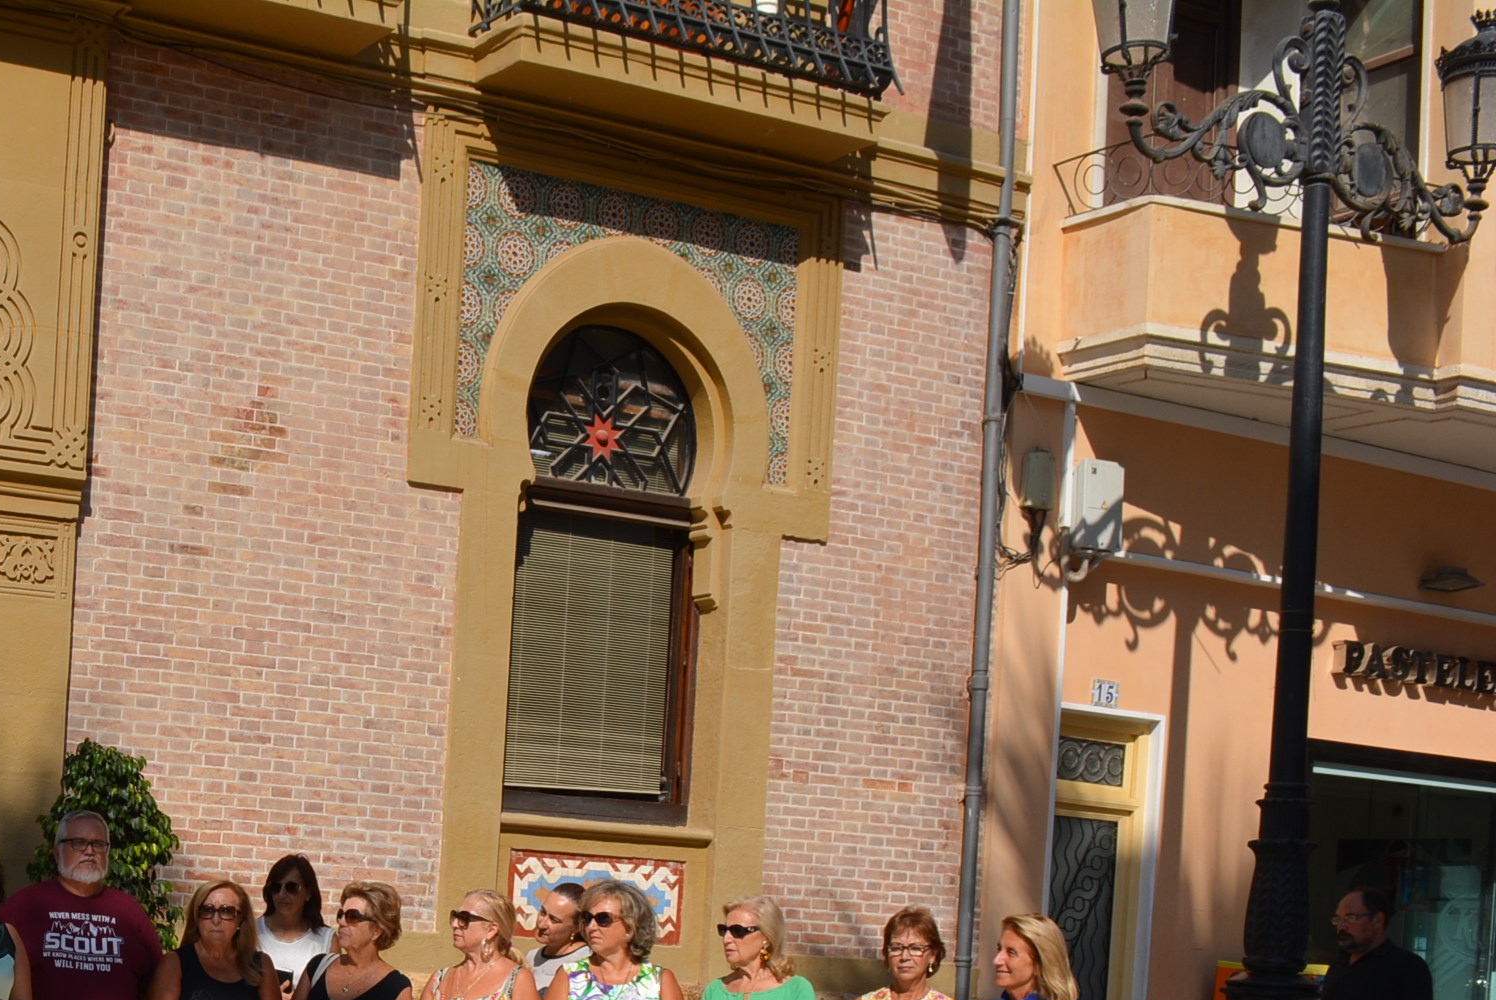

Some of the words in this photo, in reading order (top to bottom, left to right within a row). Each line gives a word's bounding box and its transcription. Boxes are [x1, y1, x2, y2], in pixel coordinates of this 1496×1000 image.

[1097, 684, 1114, 703] 15
[49, 911, 70, 920] NEVER
[71, 912, 90, 921] MESS
[91, 914, 110, 923] WITH
[44, 932, 123, 955] SCOUT
[68, 953, 87, 961] PLACES
[54, 959, 74, 969] WILL
[75, 961, 94, 971] FIND
[96, 963, 111, 972] YOU
